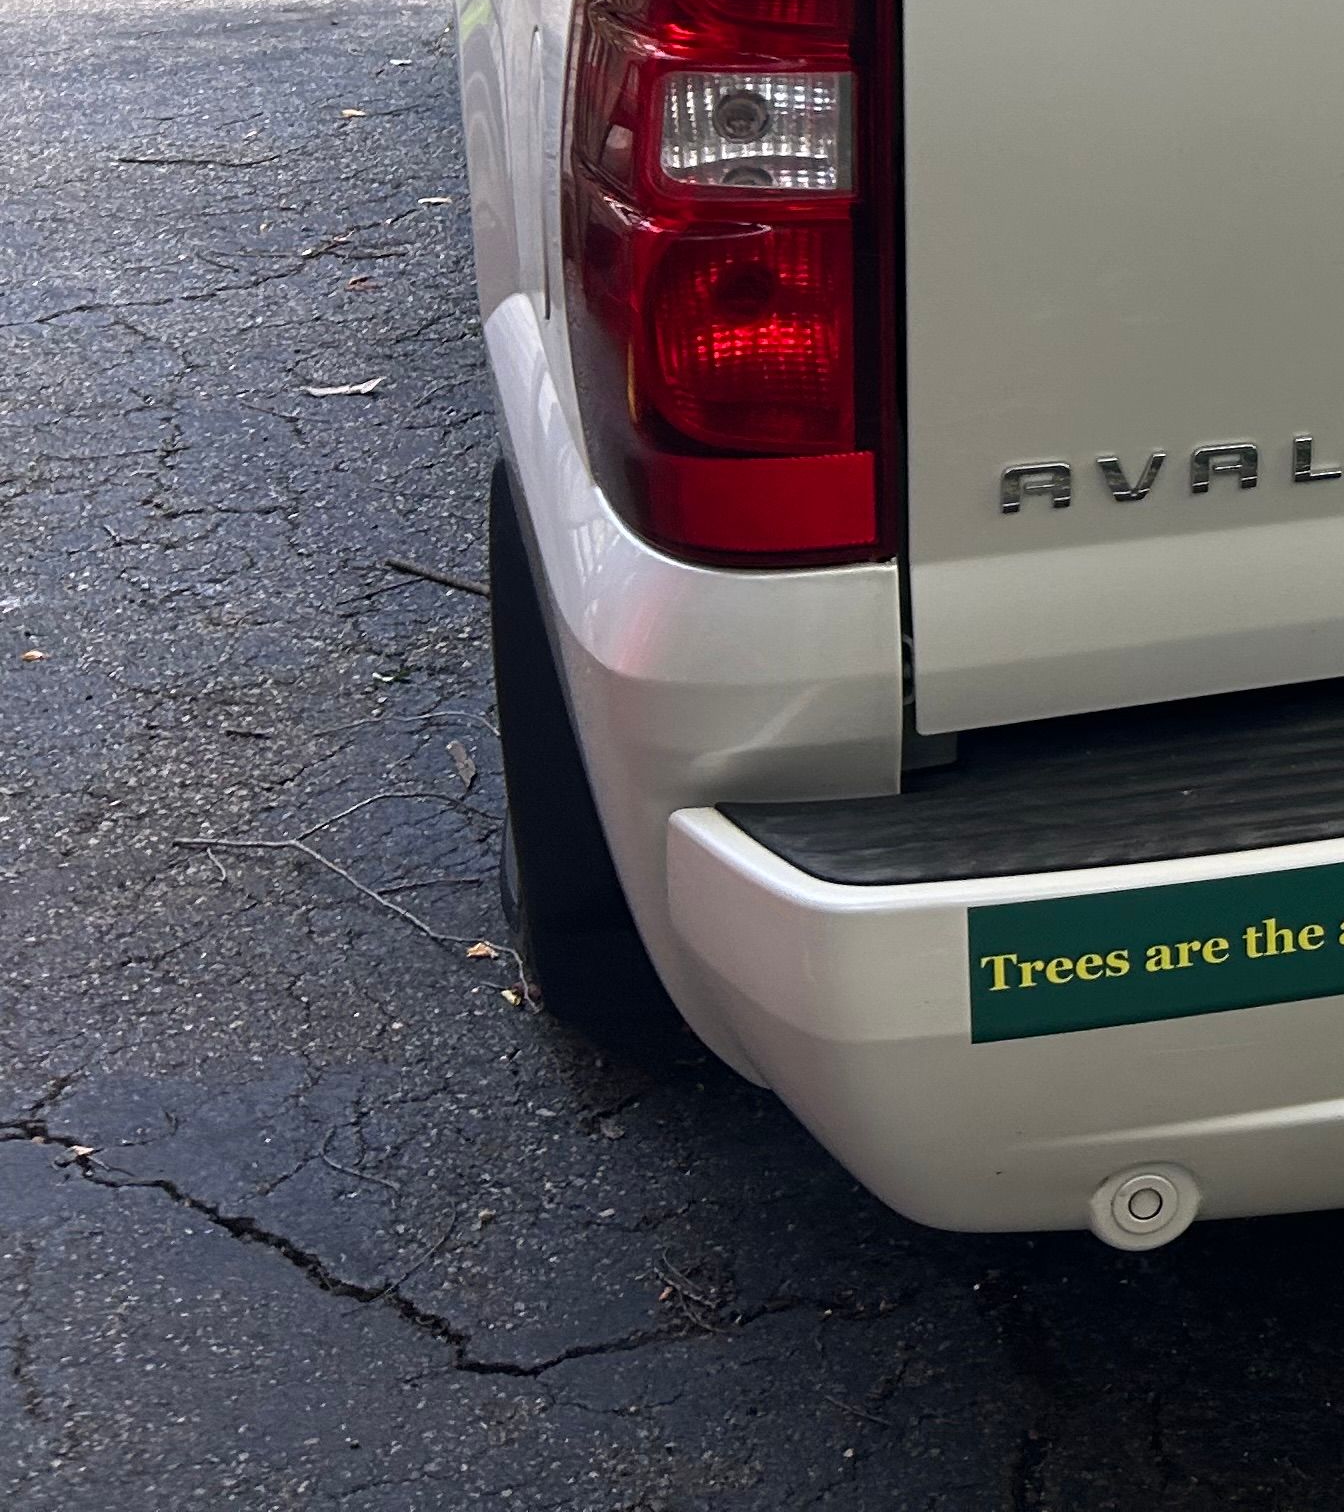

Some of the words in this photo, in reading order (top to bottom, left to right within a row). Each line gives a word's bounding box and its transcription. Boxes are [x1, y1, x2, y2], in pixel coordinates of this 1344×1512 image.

[980, 948, 1130, 991] Trees
[1145, 936, 1230, 973] are
[1242, 918, 1325, 957] the
